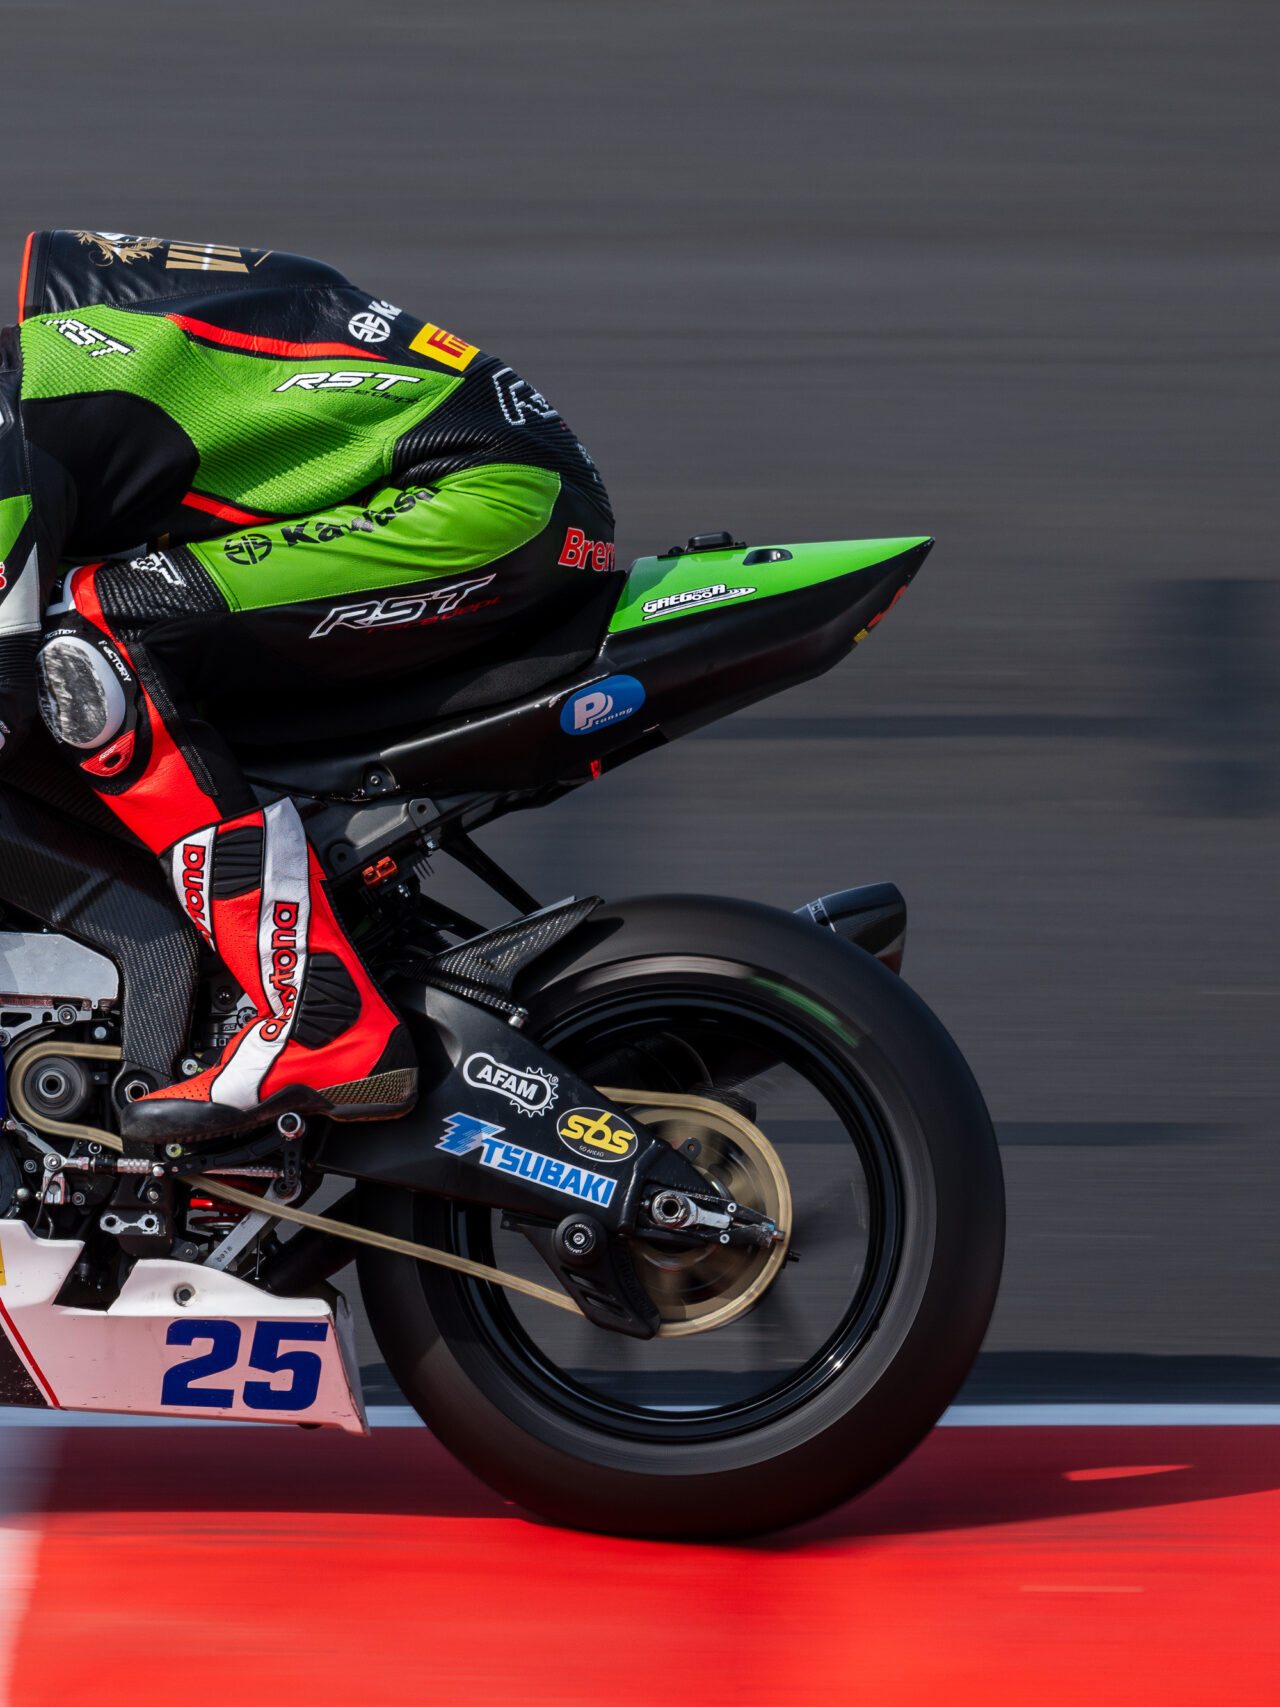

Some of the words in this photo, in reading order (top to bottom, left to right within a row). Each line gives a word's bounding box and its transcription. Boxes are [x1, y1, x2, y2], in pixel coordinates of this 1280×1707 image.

[272, 371, 424, 393] RST
[308, 573, 497, 639] RST
[476, 1064, 539, 1101] AFAM
[559, 1112, 636, 1155] sbs
[482, 1138, 615, 1206] TSUBAKI
[161, 1319, 329, 1411] 25
